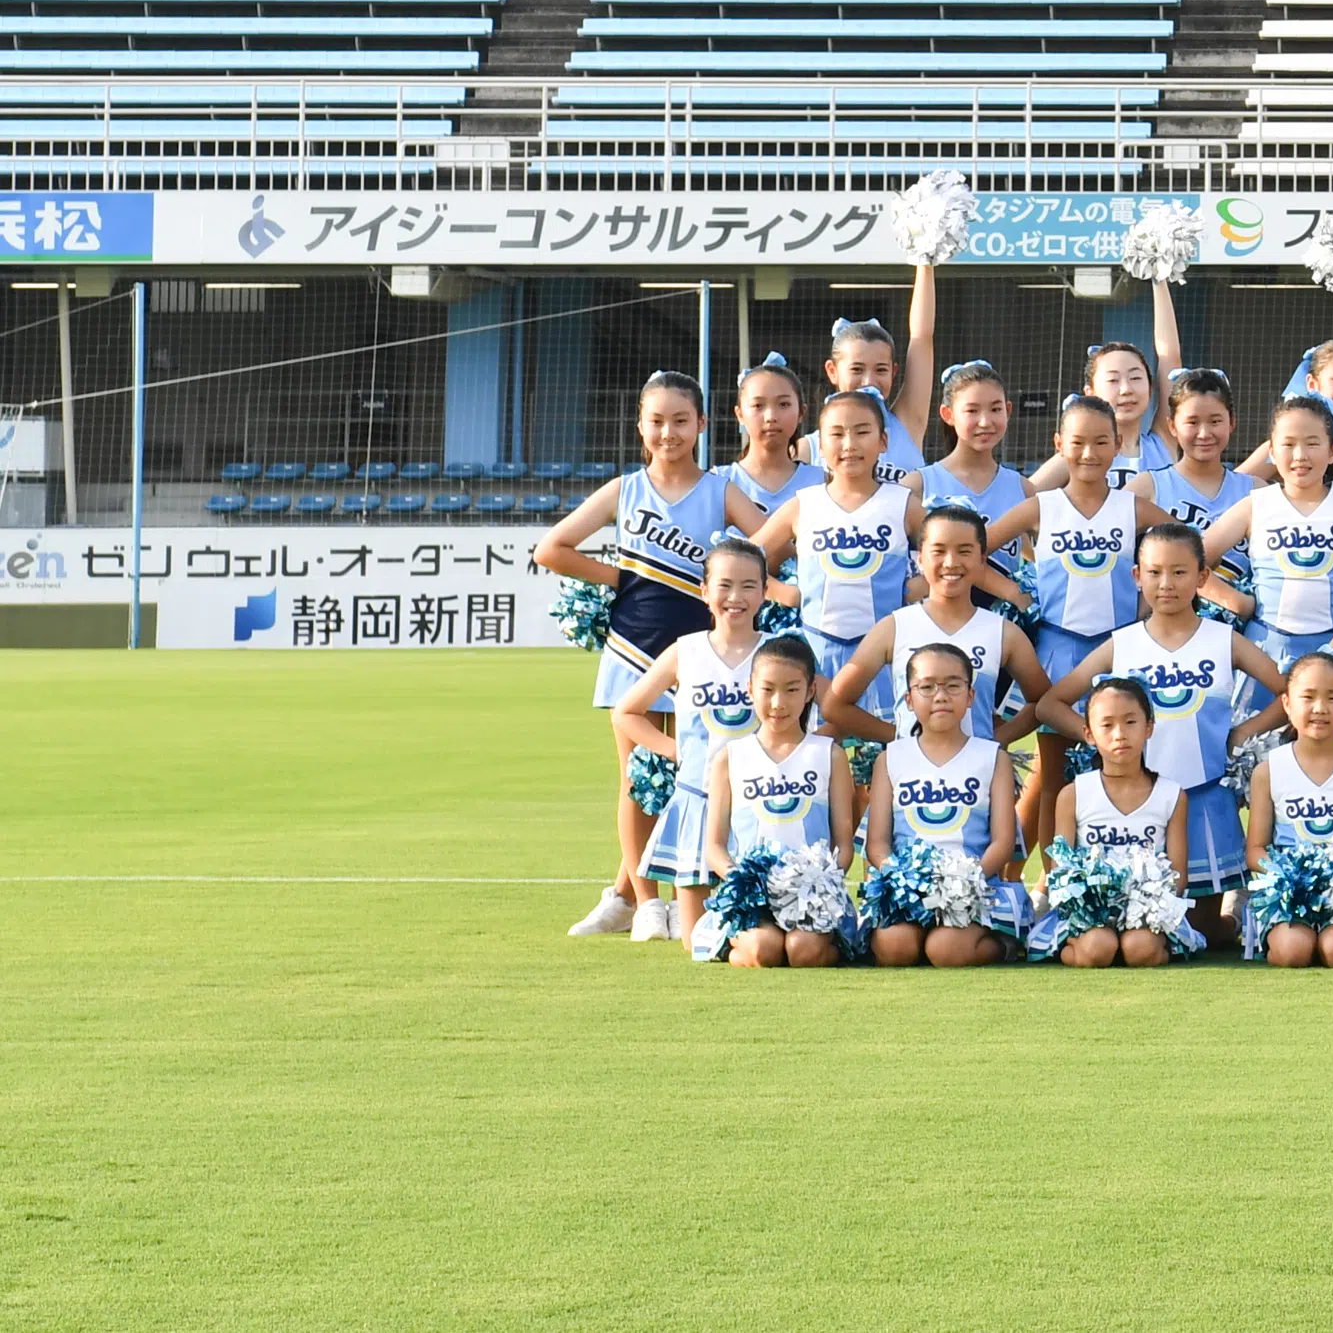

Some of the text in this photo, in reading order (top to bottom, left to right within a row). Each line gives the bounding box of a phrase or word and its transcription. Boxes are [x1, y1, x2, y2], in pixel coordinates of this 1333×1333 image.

[304, 202, 883, 254] アイジーコンサルティング
[291, 593, 516, 645] 静岡新聞
